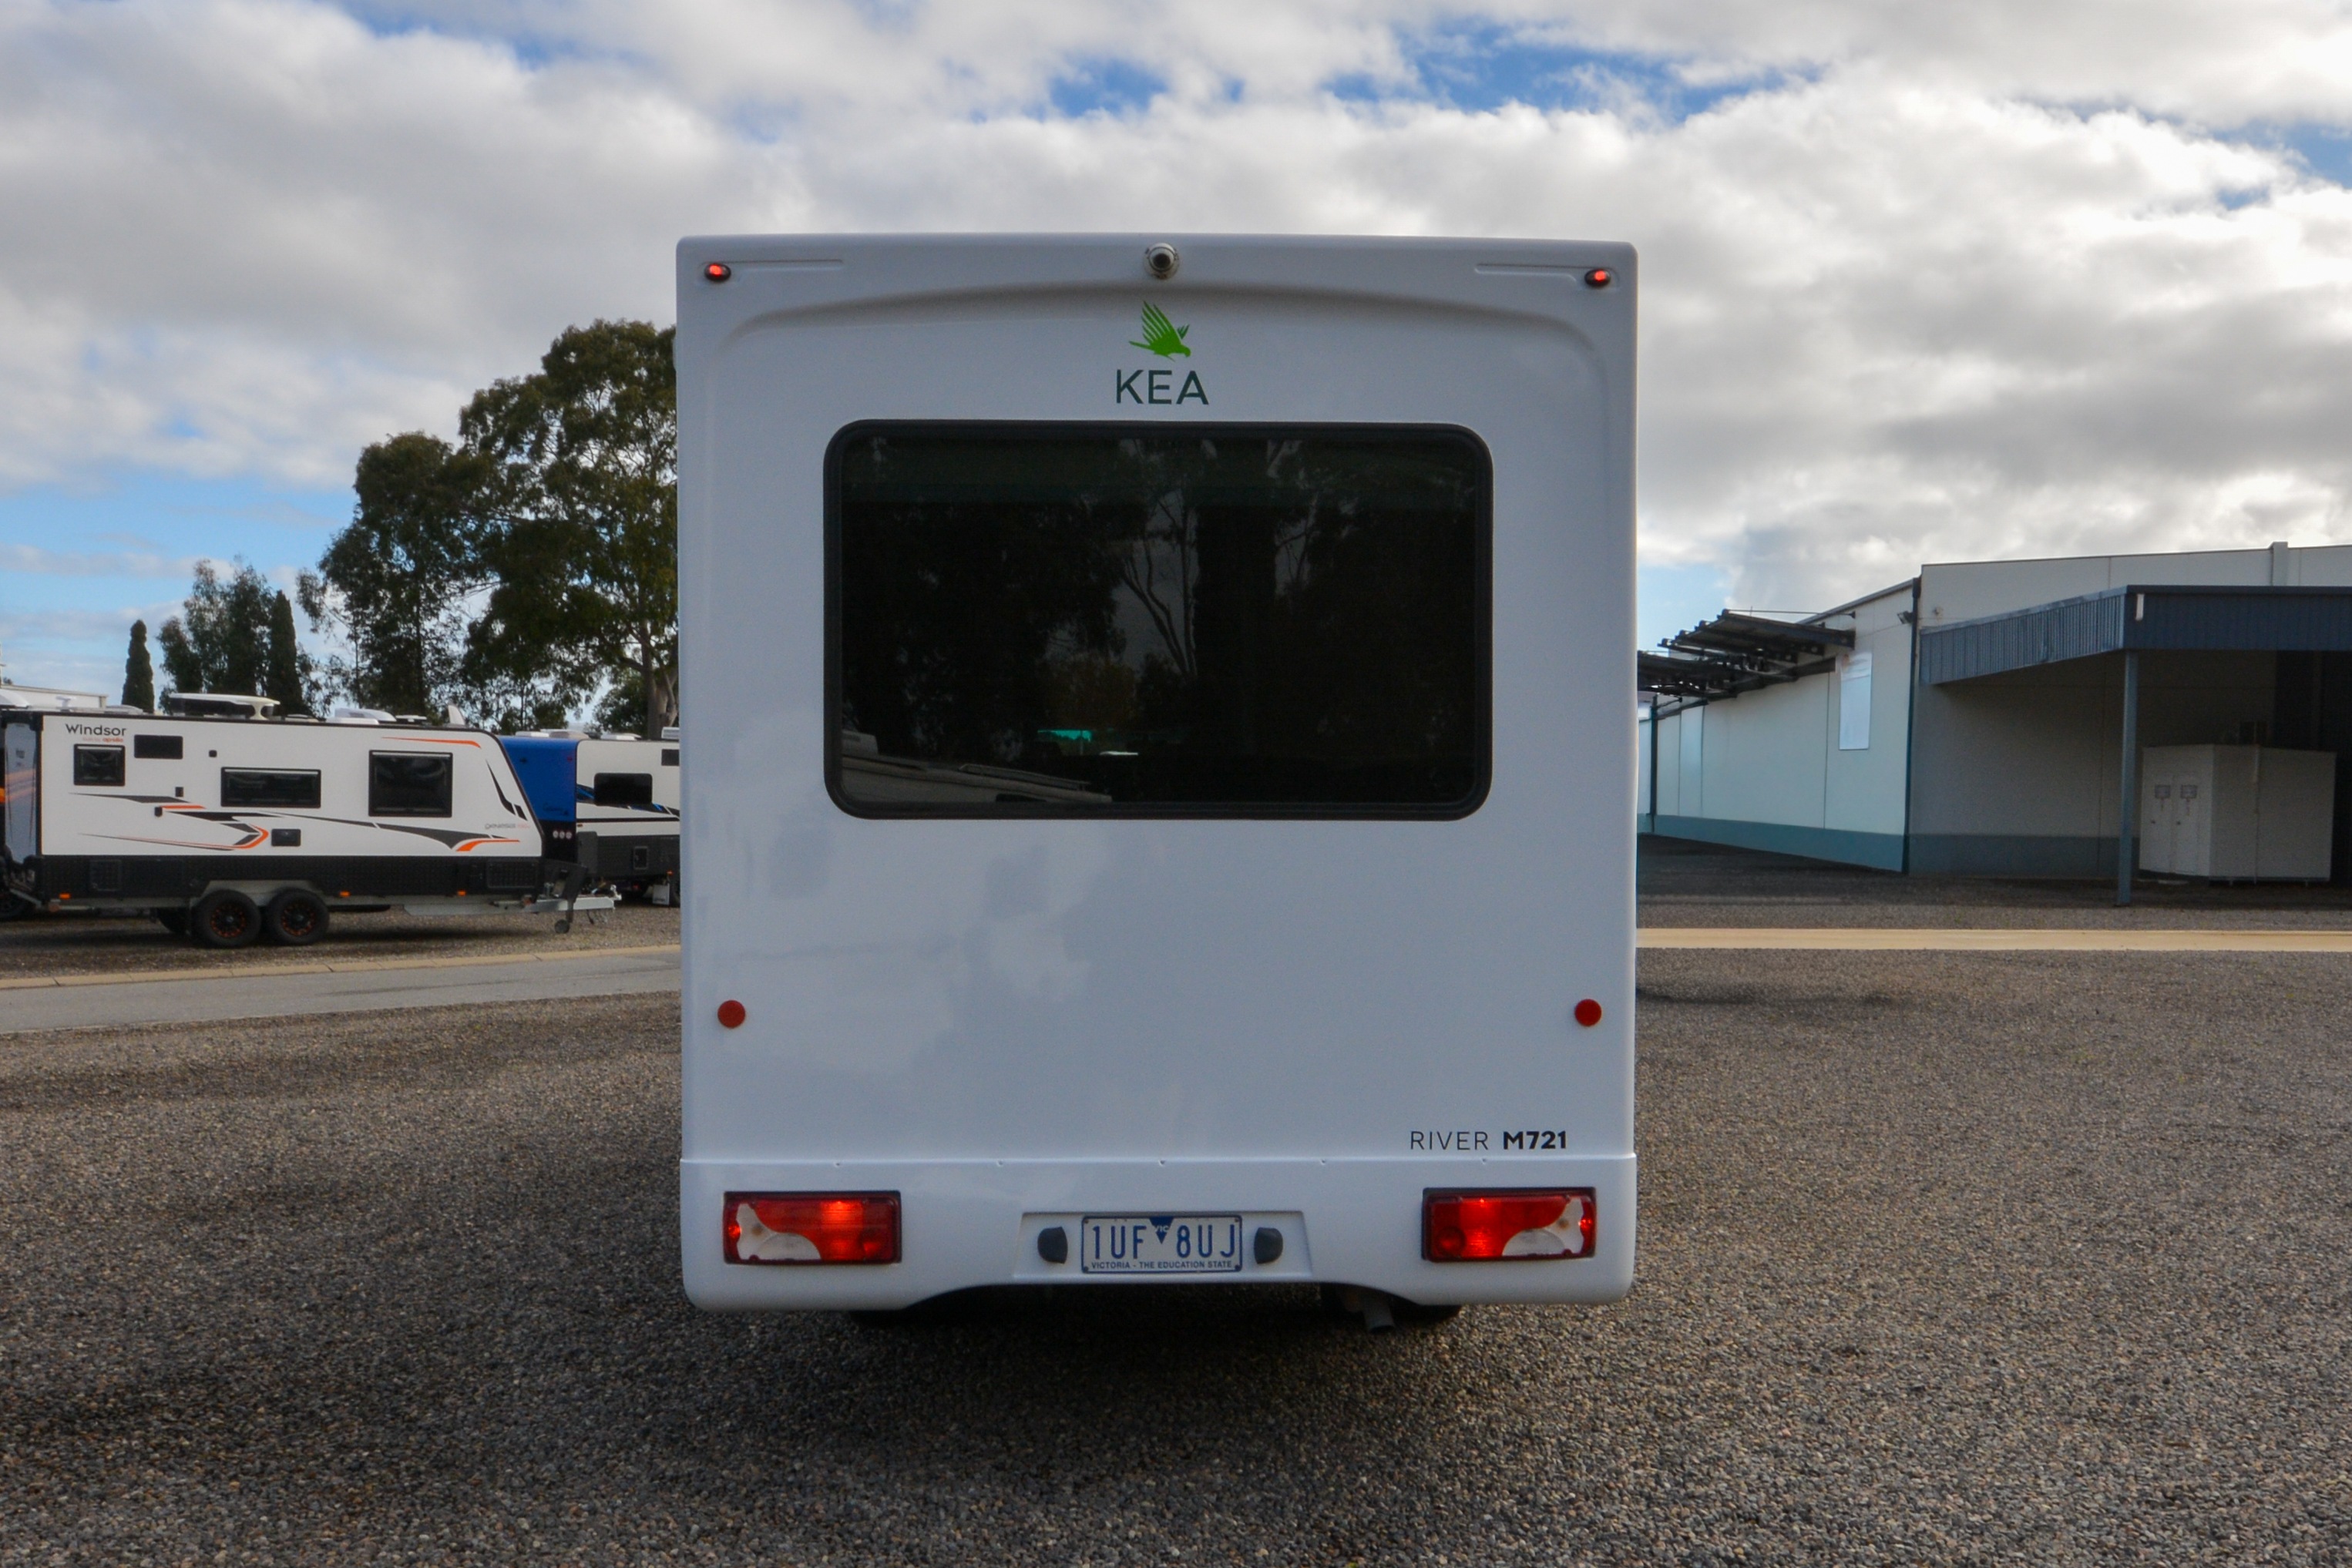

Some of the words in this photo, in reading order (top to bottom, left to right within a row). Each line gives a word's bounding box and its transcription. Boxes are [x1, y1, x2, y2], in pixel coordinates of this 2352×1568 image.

[1116, 369, 1209, 405] KEA
[65, 724, 127, 737] Windsor
[1410, 1130, 1489, 1150] RIVER
[1503, 1130, 1567, 1150] M721
[1093, 1225, 1147, 1259] 1UF
[1177, 1224, 1235, 1258] 8UJ
